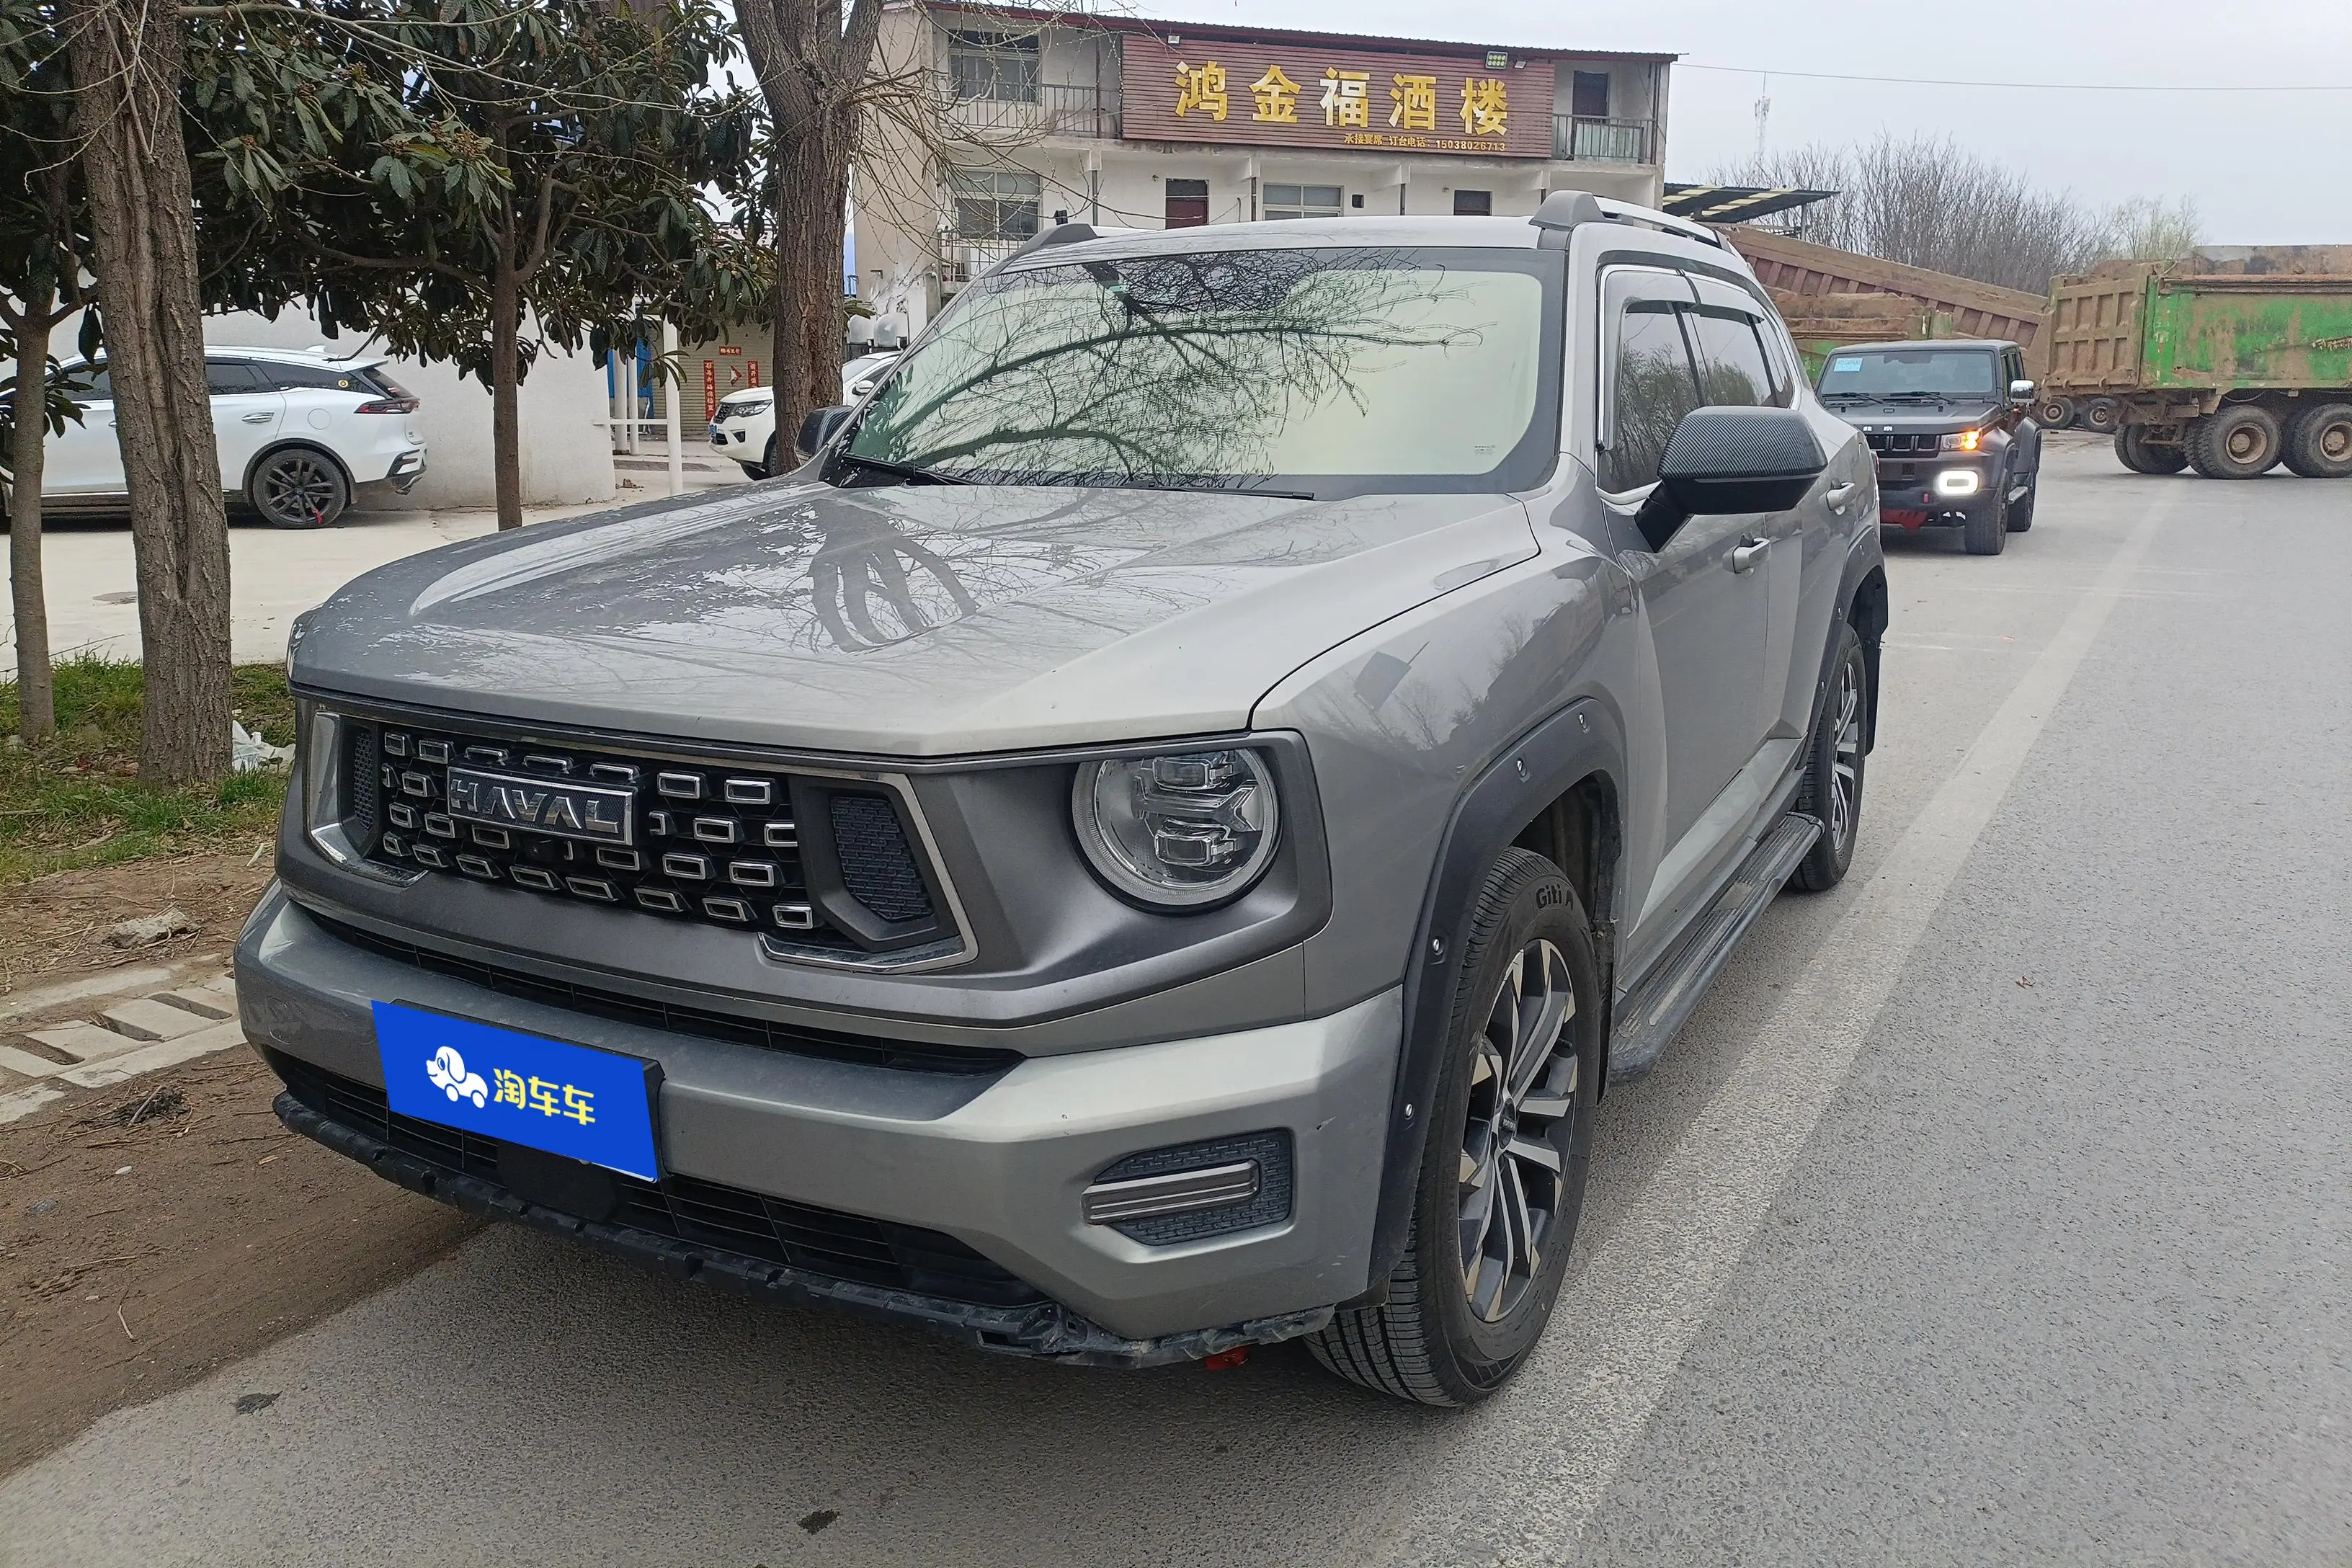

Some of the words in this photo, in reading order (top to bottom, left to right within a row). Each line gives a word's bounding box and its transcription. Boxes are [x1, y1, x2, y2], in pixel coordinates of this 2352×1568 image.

[1175, 61, 1507, 135] 鸿金福酒楼
[1435, 139, 1506, 152] 15038026713
[450, 779, 619, 833] HAVAL
[1536, 883, 1563, 909] Giti
